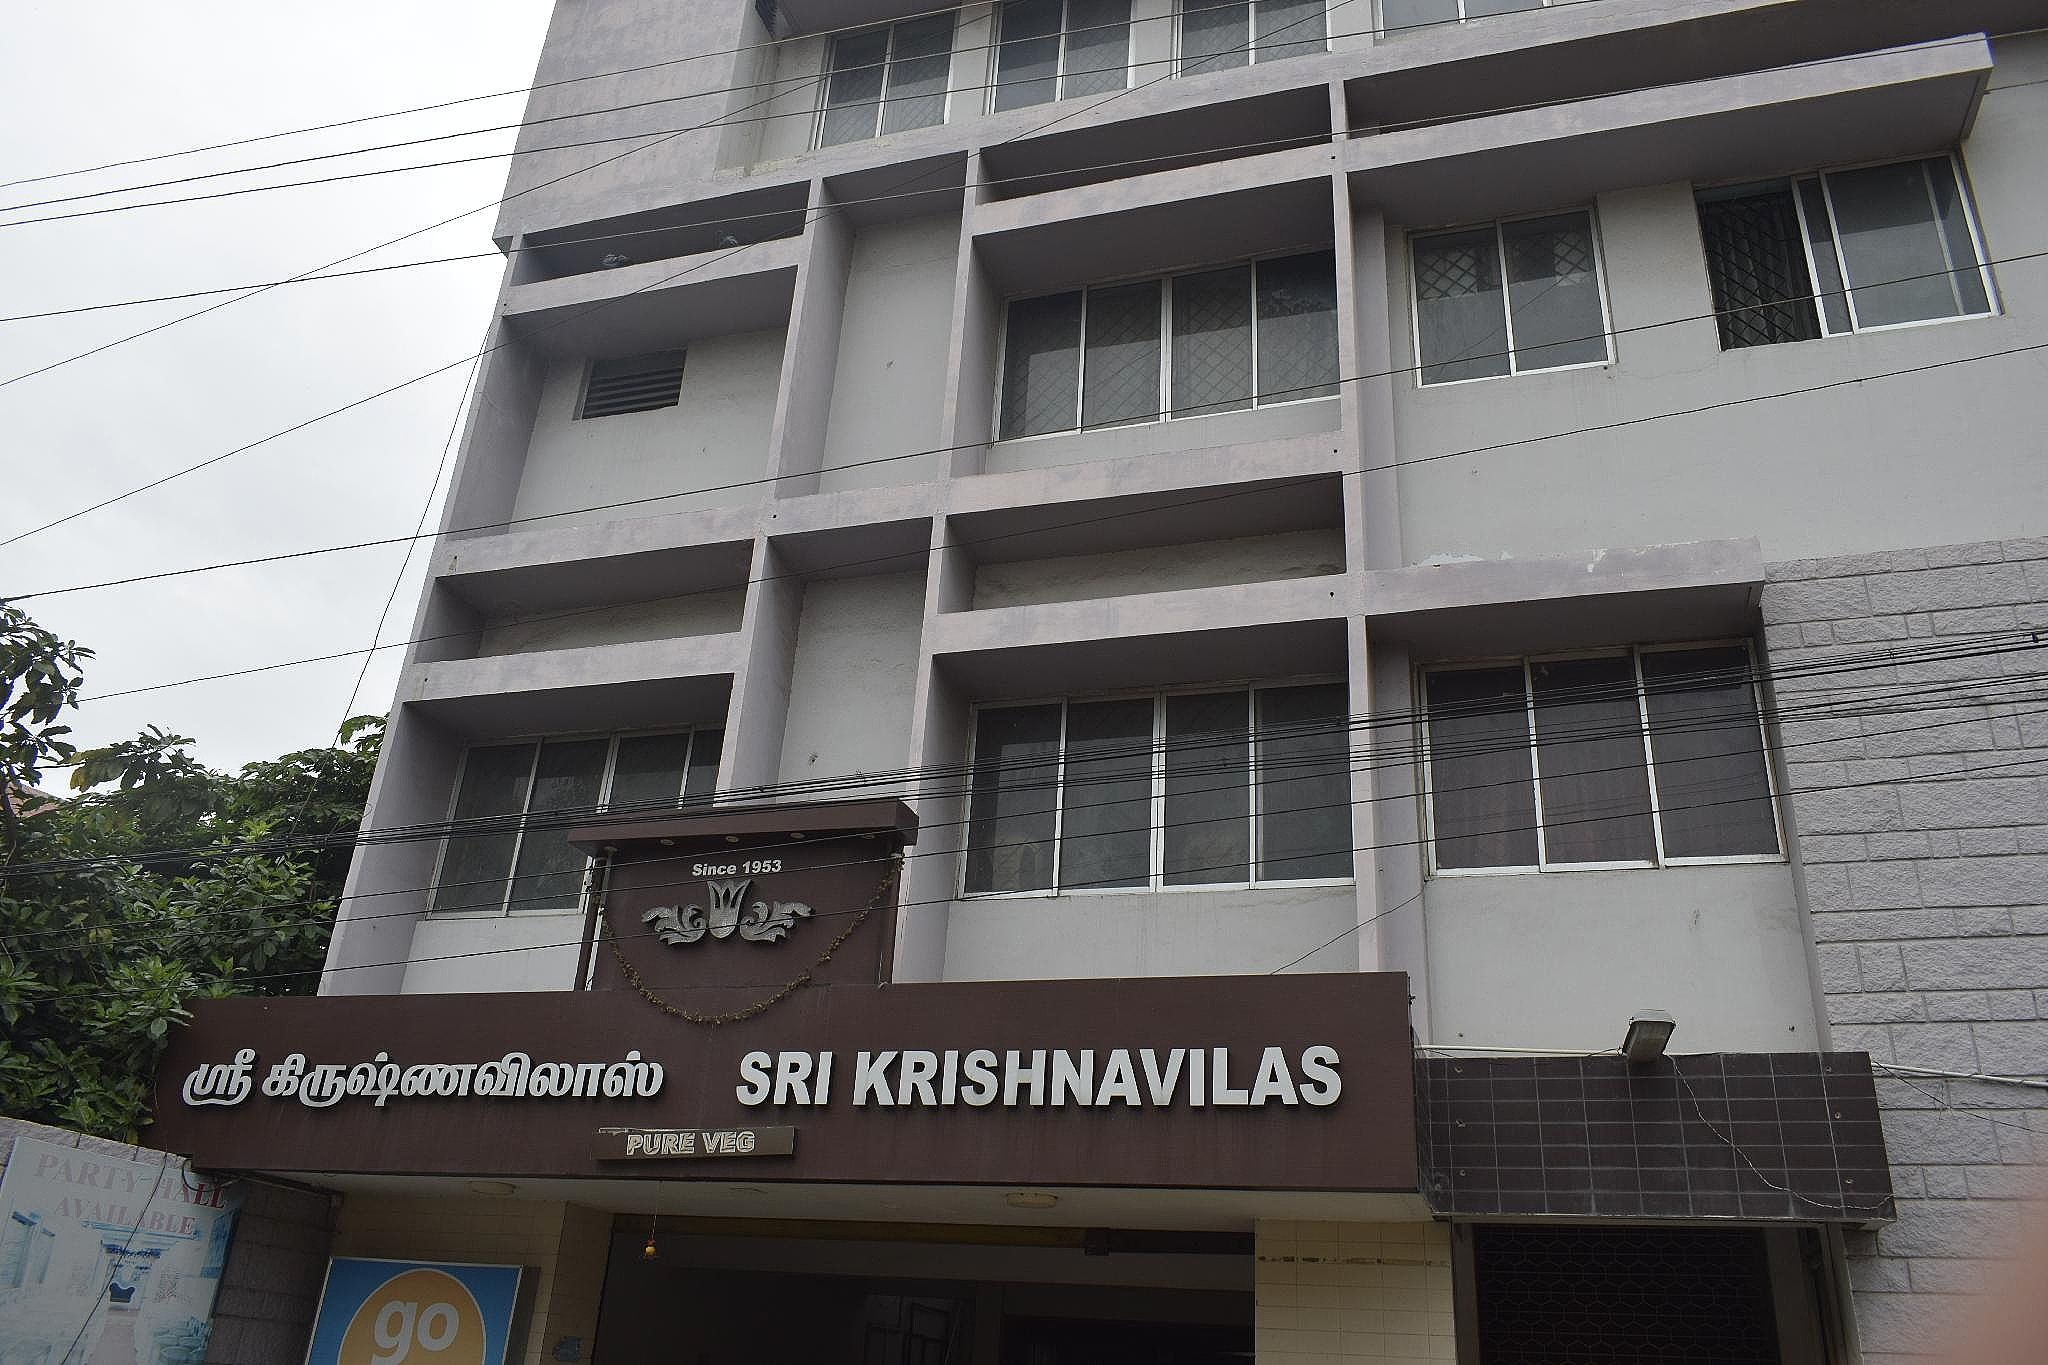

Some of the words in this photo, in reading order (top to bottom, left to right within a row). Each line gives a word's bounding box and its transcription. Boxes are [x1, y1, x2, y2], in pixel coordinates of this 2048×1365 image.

[691, 863, 737, 876] Since
[742, 859, 782, 874] 1953
[182, 1048, 256, 1106] ஸ்ரீ
[261, 1049, 664, 1108] கிருஷ்ணவிலாஸ்
[736, 1050, 833, 1106] SRI
[853, 1045, 1343, 1107] KRISHNAVILAS
[626, 1132, 695, 1156] PURE
[702, 1131, 756, 1154] VEG
[34, 1153, 141, 1193] PARTY
[152, 1174, 228, 1209] HALL
[54, 1196, 199, 1236] AVAILABLE
[370, 1299, 460, 1365] go
